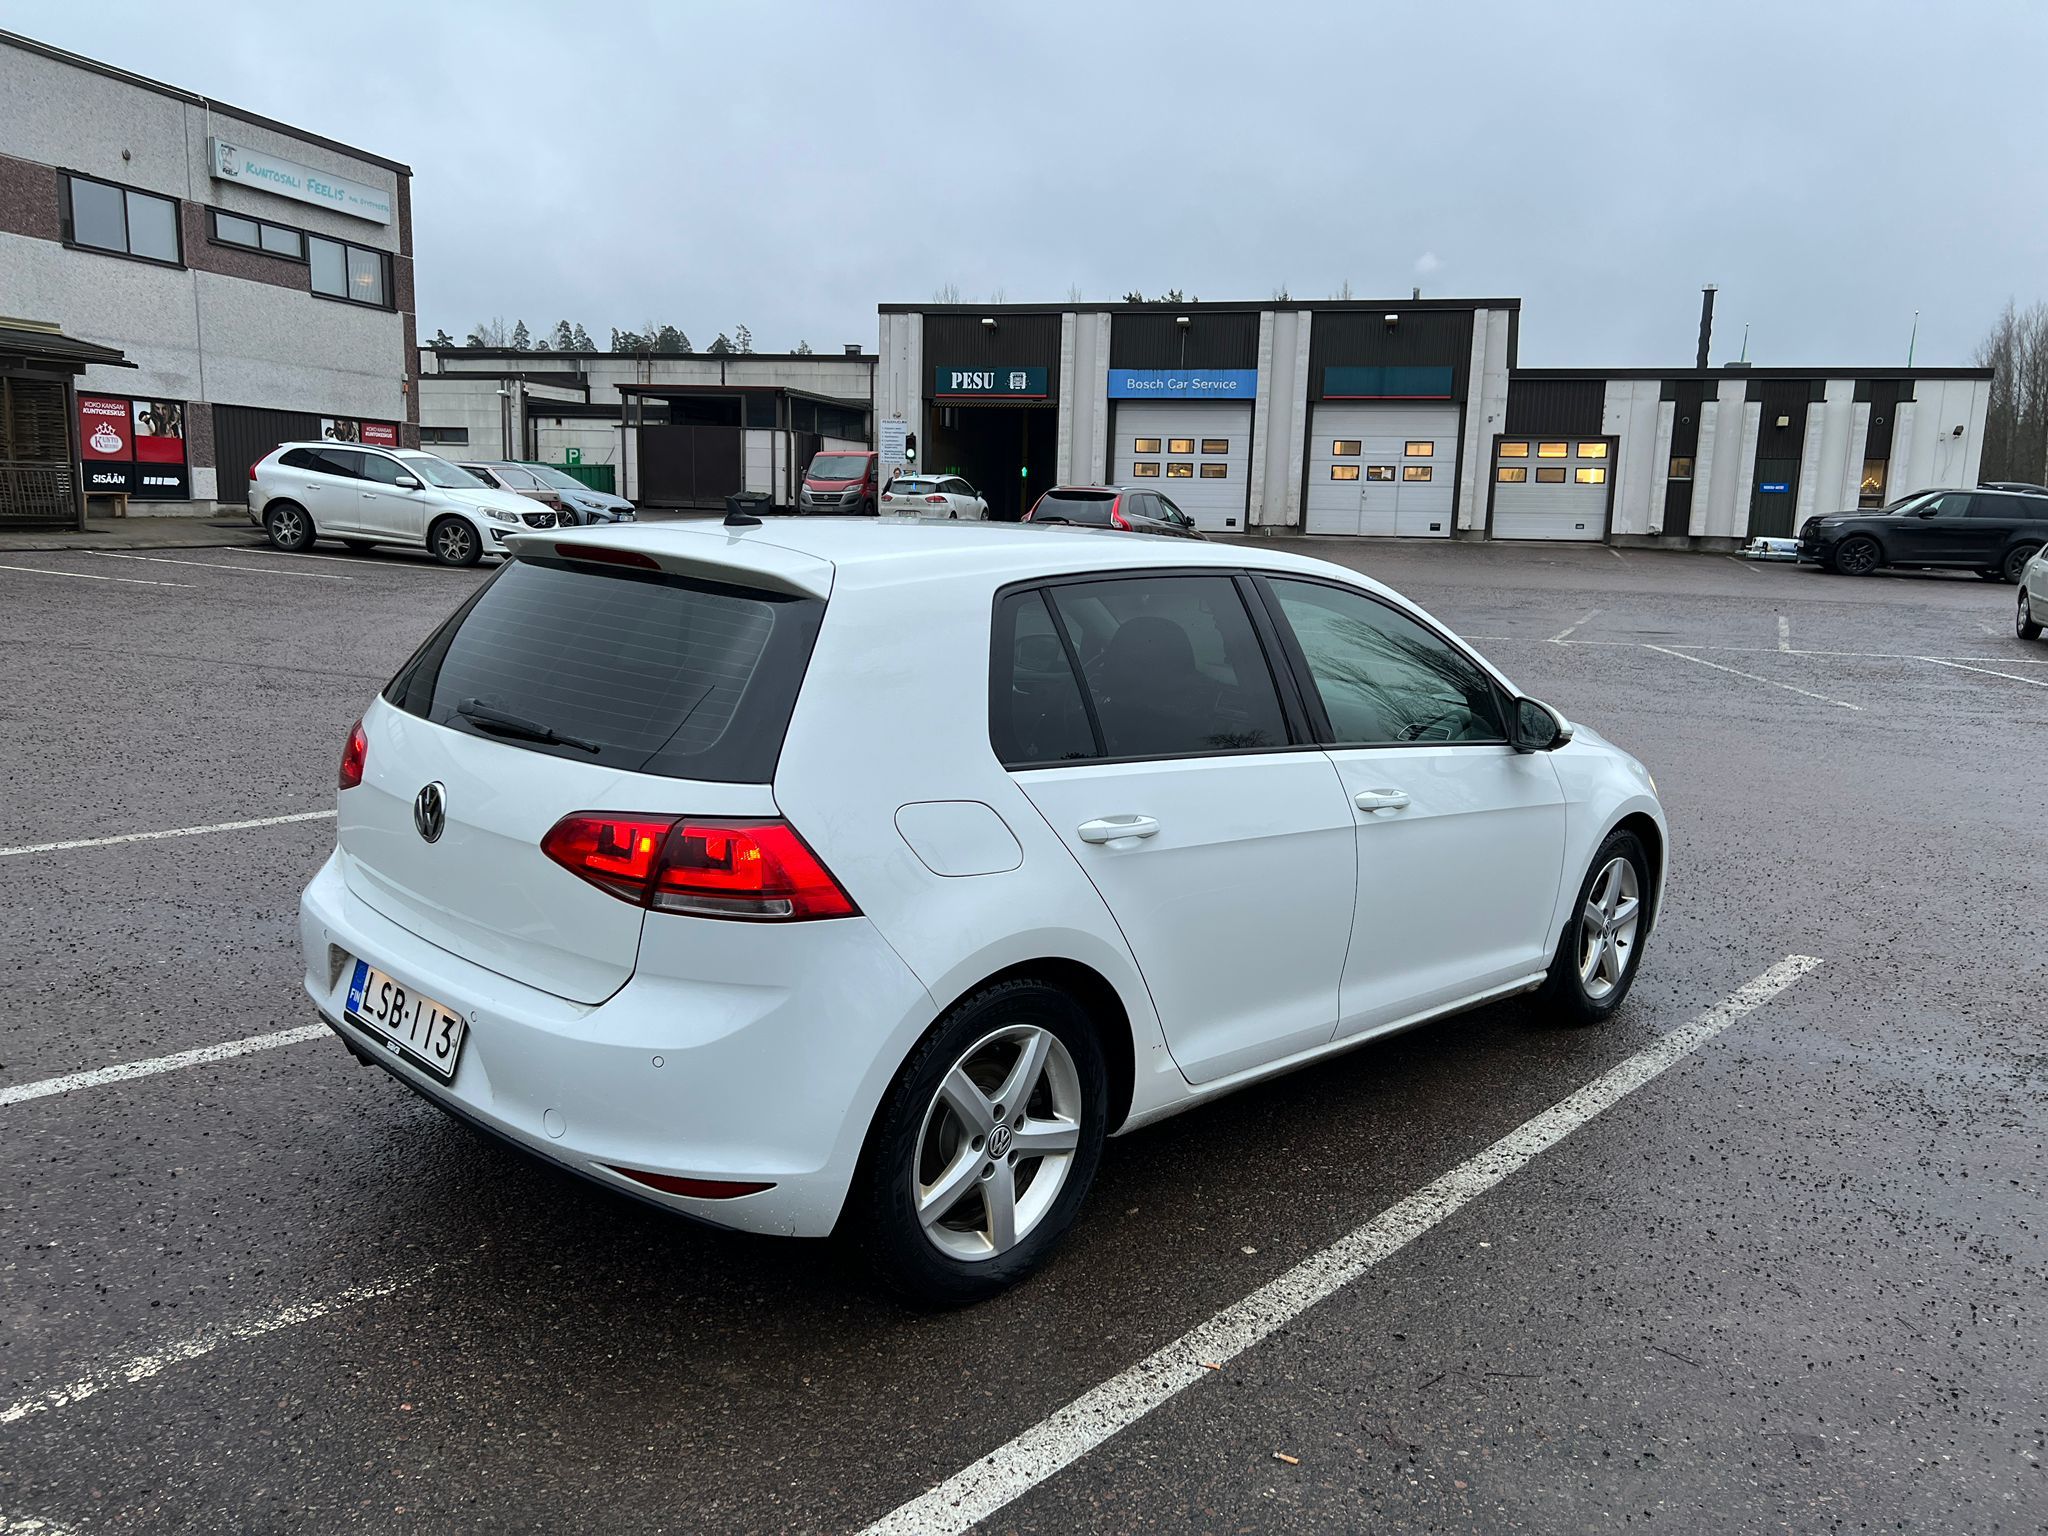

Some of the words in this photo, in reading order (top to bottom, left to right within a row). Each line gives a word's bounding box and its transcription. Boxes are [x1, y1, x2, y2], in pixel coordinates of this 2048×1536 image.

[245, 162, 301, 188] KUNTOSALI
[306, 178, 345, 201] FEELIS
[951, 372, 995, 389] PESU
[1127, 378, 1164, 389] Bosch
[1167, 378, 1188, 389] Car
[1191, 378, 1237, 389] Service
[82, 407, 126, 417] KUNTOKESKUS
[84, 401, 101, 409] KOKO
[102, 402, 125, 410] KANSAN
[568, 449, 579, 464] P
[92, 472, 126, 484] SISÄÄN
[349, 987, 362, 1004] FIN
[362, 971, 457, 1059] LSB-113
